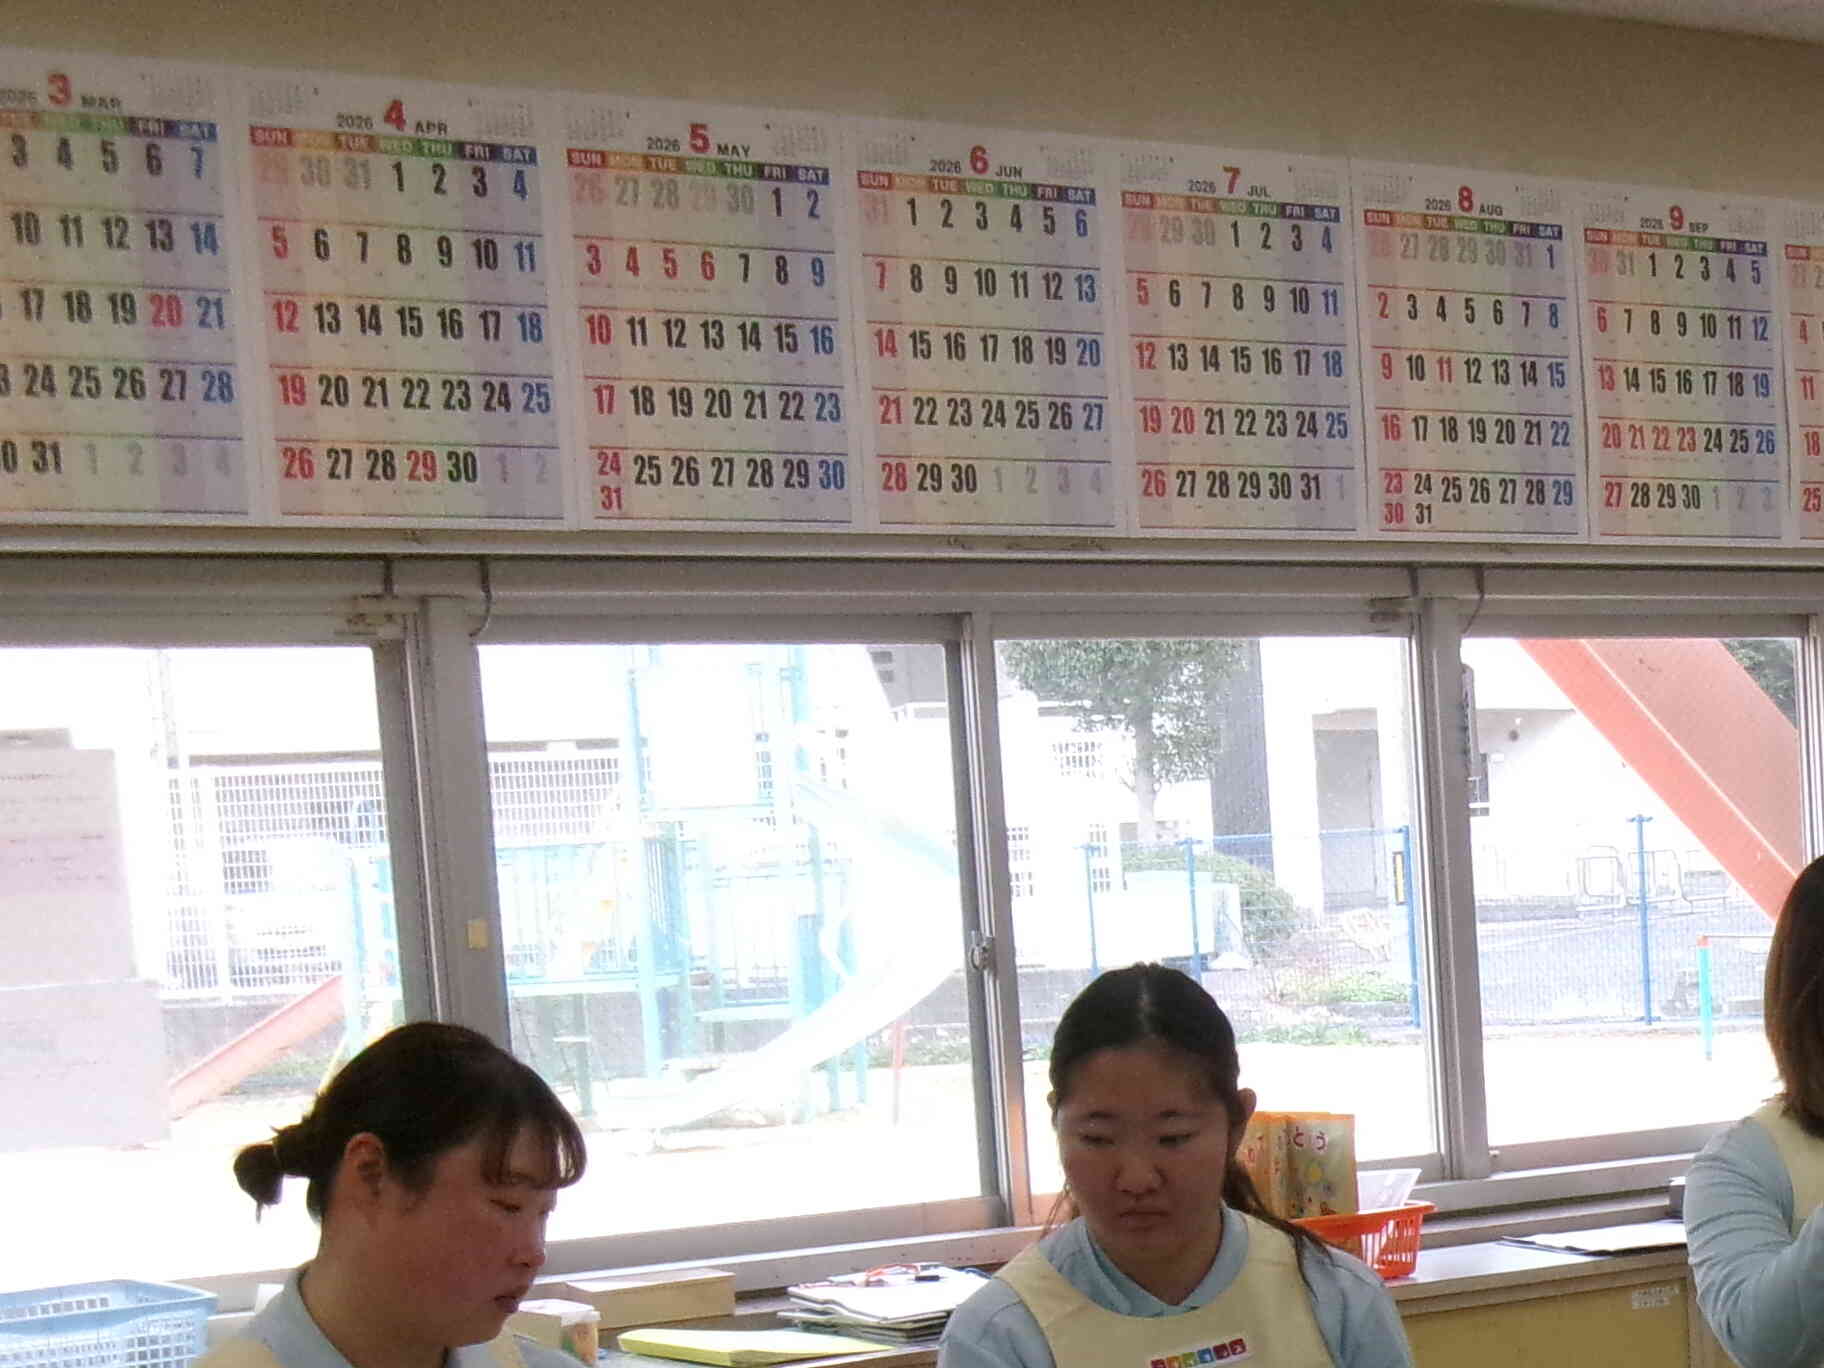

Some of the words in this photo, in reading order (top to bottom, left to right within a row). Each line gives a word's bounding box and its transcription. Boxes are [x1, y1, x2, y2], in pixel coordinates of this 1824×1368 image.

[49, 73, 71, 105] 3
[337, 113, 374, 130] 2026
[384, 100, 406, 131] 4
[415, 120, 448, 136] APR
[10, 132, 28, 168] 3
[56, 136, 73, 171] 4
[100, 139, 119, 173] 5
[144, 142, 163, 177] 6
[190, 145, 204, 180] 7
[255, 130, 288, 145] SUN
[464, 145, 490, 159] FRI
[503, 148, 530, 163] SAT
[647, 137, 680, 152] 2026
[689, 124, 710, 153] 5
[717, 144, 750, 158] MAY
[571, 153, 601, 167] SUN
[650, 157, 677, 170] TUE
[724, 163, 752, 176] THU
[764, 166, 786, 179] FRI
[798, 168, 823, 181] SAT
[930, 160, 962, 174] 2026
[970, 146, 989, 174] 6
[995, 166, 1023, 179] JUN
[861, 173, 889, 186] SUN
[932, 179, 958, 191] TUE
[1002, 184, 1027, 196] THU
[1037, 187, 1057, 199] FRI
[1068, 189, 1091, 201] SAT
[1188, 180, 1216, 194] 2026
[1223, 166, 1240, 194] 7
[1248, 186, 1271, 198] JUL
[1285, 206, 1304, 217] FRI
[1314, 208, 1335, 220] SAT
[1426, 198, 1450, 211] 2026
[1458, 186, 1474, 212] 8
[1479, 204, 1503, 217] AUG
[1670, 205, 1684, 230] 9
[9, 210, 41, 245] 10
[58, 213, 84, 247] 11
[100, 215, 130, 250] 12
[144, 218, 175, 253] 13
[190, 221, 219, 256] 14
[271, 298, 299, 333] 12
[313, 301, 341, 334] 13
[355, 303, 382, 336] 14
[395, 305, 424, 338] 15
[436, 307, 464, 340] 16
[478, 309, 501, 342] 17
[517, 311, 544, 344] 18
[585, 313, 612, 345] 10
[626, 315, 648, 346] 11
[662, 317, 687, 348] 12
[699, 319, 725, 350] 13
[737, 321, 762, 352] 14
[773, 322, 799, 354] 15
[809, 324, 834, 355] 16
[873, 327, 898, 358] 14
[908, 329, 932, 360] 15
[943, 331, 967, 362] 16
[979, 333, 999, 363] 17
[1011, 334, 1034, 364] 18
[1044, 336, 1067, 366] 19
[1076, 337, 1101, 367] 20
[1135, 340, 1157, 371] 12
[1167, 342, 1189, 372] 13
[1199, 344, 1220, 372] 14
[1230, 345, 1252, 374] 15
[1261, 347, 1283, 376] 16
[1293, 348, 1311, 376] 17
[1322, 349, 1343, 378] 18
[1380, 352, 1393, 380] 9
[1405, 354, 1426, 382] 10
[1436, 355, 1453, 384] 11
[1463, 356, 1482, 384] 12
[1491, 358, 1511, 386] 13
[1519, 360, 1539, 387] 14
[1546, 361, 1566, 389] 15
[1597, 364, 1616, 392] 13
[1622, 366, 1641, 392] 14
[1648, 367, 1667, 394] 15
[1675, 368, 1693, 395] 16
[1702, 370, 1718, 396] 17
[1726, 371, 1745, 398] 18
[1752, 372, 1770, 398] 19
[277, 372, 307, 406] 19
[317, 373, 349, 407] 20
[361, 375, 388, 408] 21
[400, 376, 431, 410] 22
[441, 378, 472, 411] 23
[481, 380, 512, 413] 24
[521, 381, 551, 415] 25
[592, 383, 615, 415] 17
[629, 384, 655, 416] 18
[667, 386, 693, 418] 19
[704, 387, 732, 419] 20
[743, 388, 767, 420] 21
[778, 390, 805, 421] 22
[814, 391, 842, 423] 23
[1138, 405, 1162, 434] 19
[1170, 405, 1195, 435] 20
[1203, 406, 1225, 435] 21
[1233, 407, 1257, 437] 22
[1264, 408, 1288, 438] 23
[1295, 410, 1319, 439] 24
[1325, 411, 1349, 440] 25
[1803, 430, 1821, 457] 18
